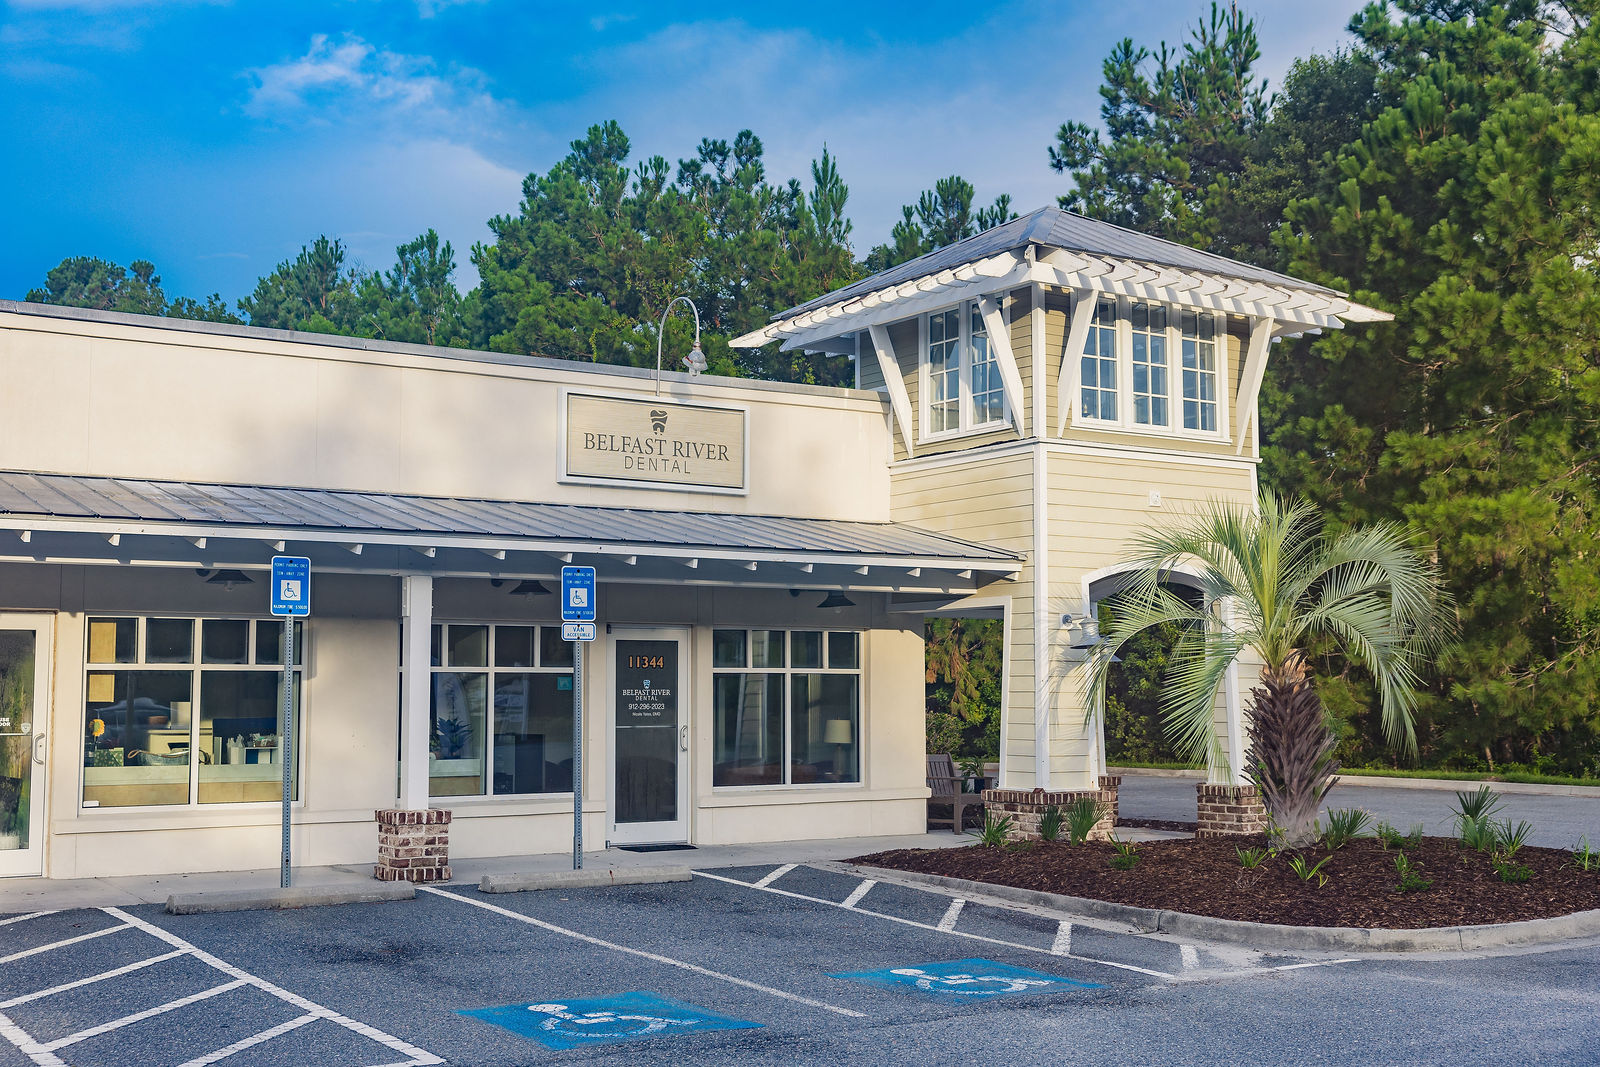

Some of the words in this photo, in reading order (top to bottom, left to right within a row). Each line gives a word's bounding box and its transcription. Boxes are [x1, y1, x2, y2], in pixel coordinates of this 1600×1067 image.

[584, 432, 667, 456] BELFAST
[672, 440, 730, 462] RIVER
[624, 455, 691, 475] DENTAL
[629, 656, 664, 668] 11344
